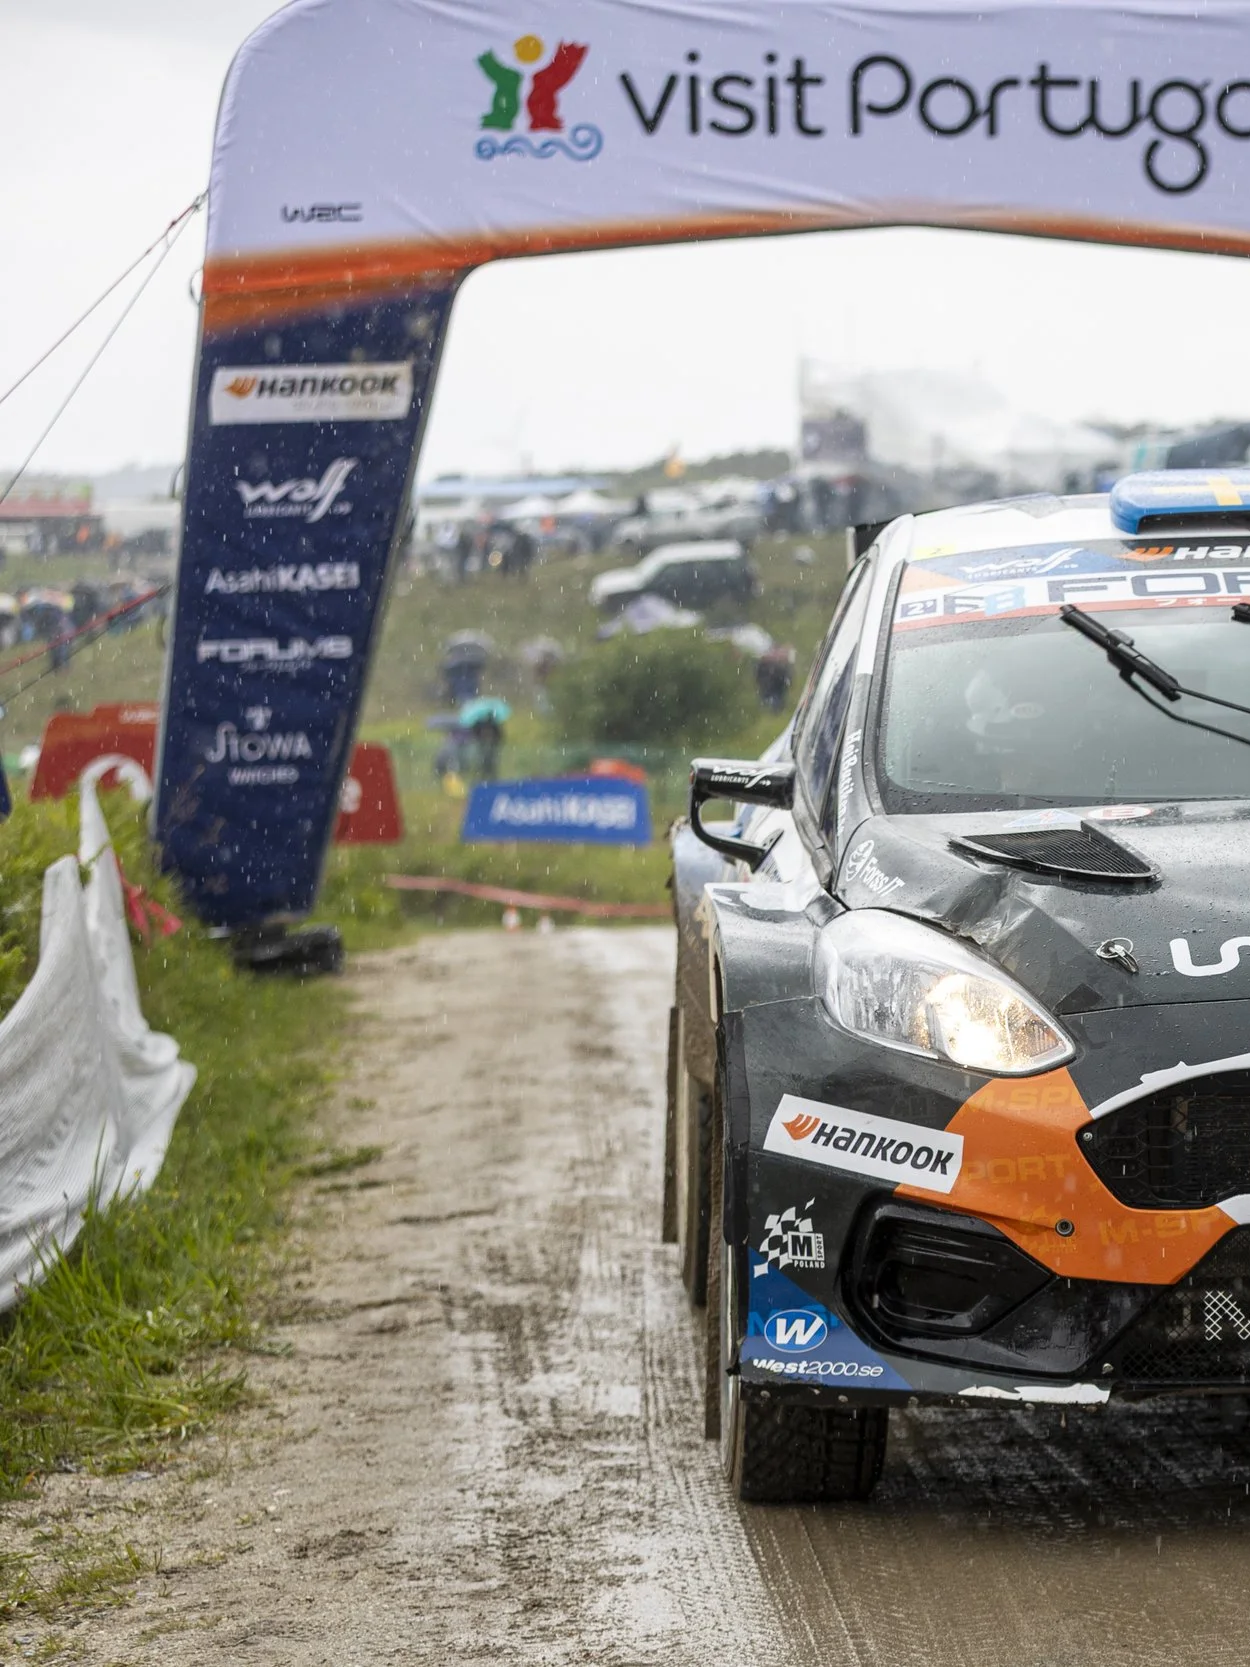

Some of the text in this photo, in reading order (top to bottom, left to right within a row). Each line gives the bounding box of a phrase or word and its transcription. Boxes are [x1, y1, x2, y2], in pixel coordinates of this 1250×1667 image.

[620, 51, 826, 138] visit
[281, 203, 362, 222] WRC
[791, 1234, 814, 1257] M
[816, 1234, 824, 1259] SPORT
[793, 1260, 826, 1269] POLAND
[775, 1317, 825, 1346] W
[752, 1358, 884, 1378] West2000.se
